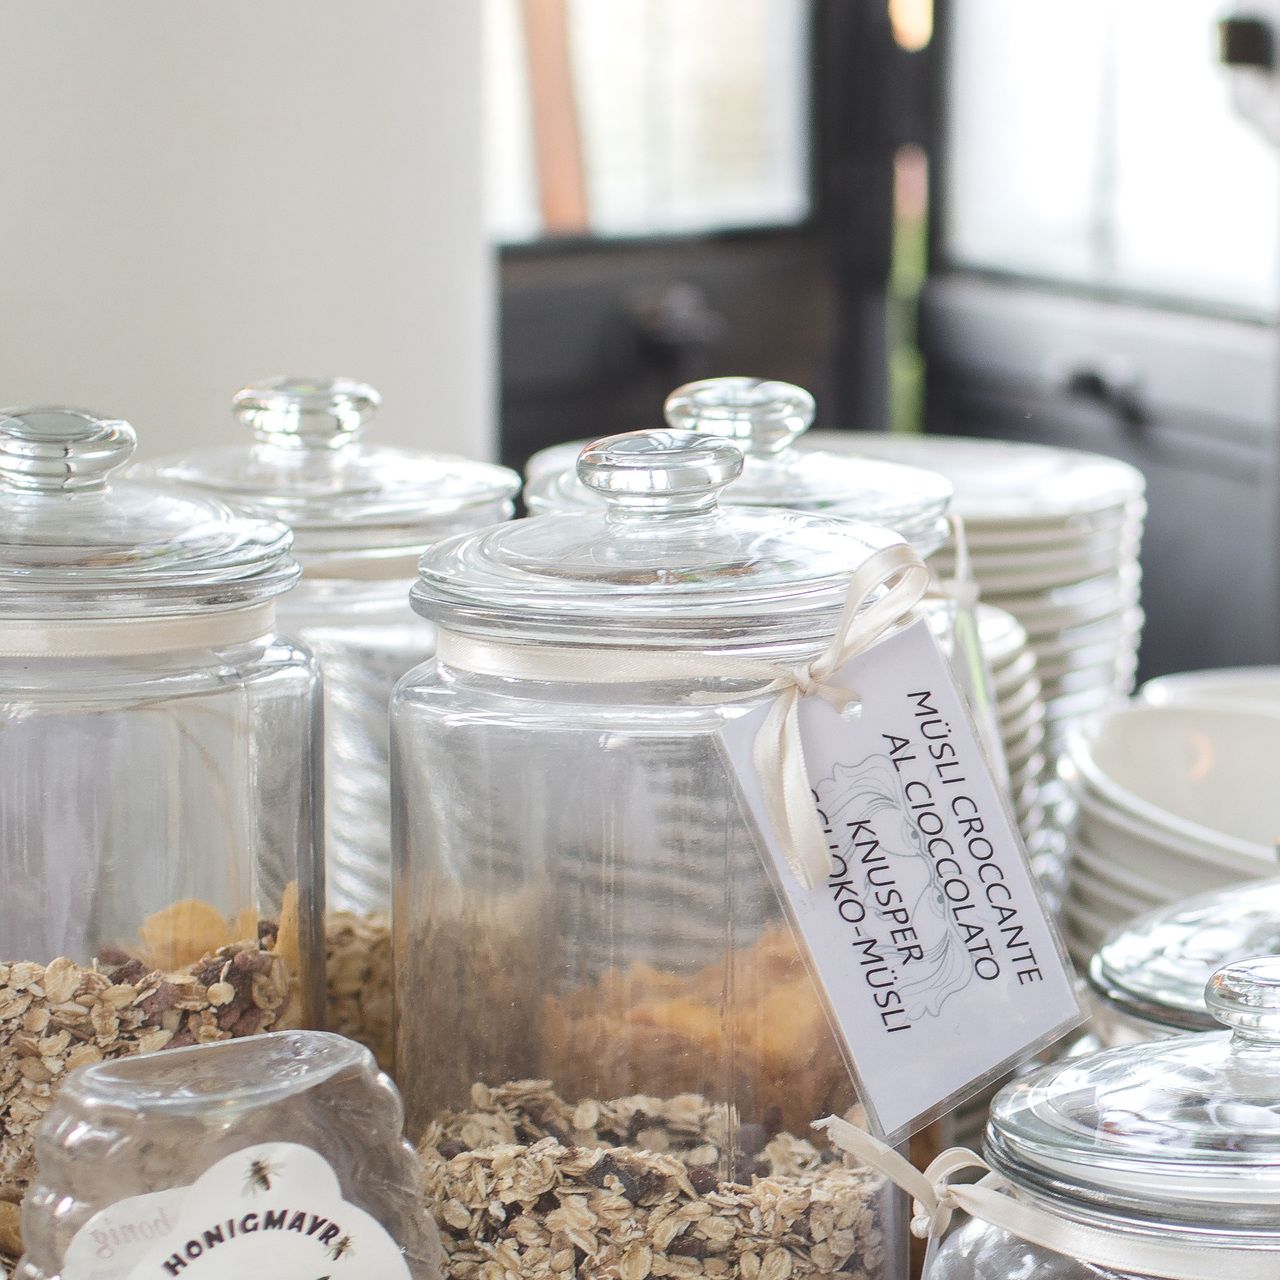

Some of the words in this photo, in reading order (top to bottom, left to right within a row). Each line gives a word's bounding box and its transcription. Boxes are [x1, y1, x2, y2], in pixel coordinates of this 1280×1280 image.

[847, 819, 924, 966] KNUSPER
[881, 733, 916, 772] AL
[905, 781, 999, 981] CIOCCOLATO
[906, 690, 965, 785] MÜSLI
[951, 796, 1043, 985] CROCCANTE
[162, 1209, 340, 1276] HONIGMAYR
